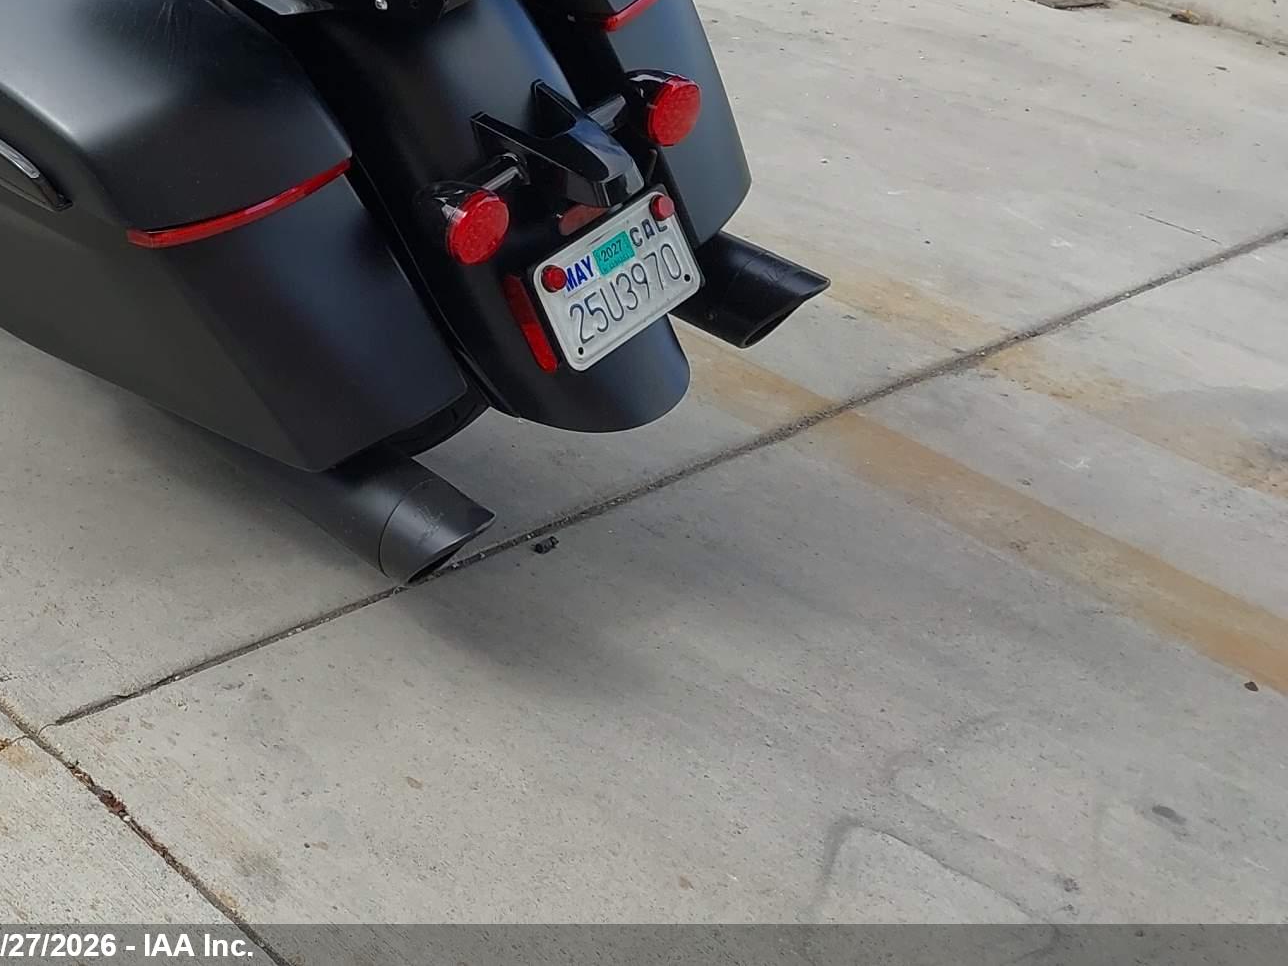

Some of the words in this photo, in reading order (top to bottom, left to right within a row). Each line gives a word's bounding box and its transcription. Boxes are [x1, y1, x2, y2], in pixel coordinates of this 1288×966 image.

[600, 239, 623, 262] 2027
[565, 255, 594, 292] MAY
[569, 243, 682, 344] 25U3970
